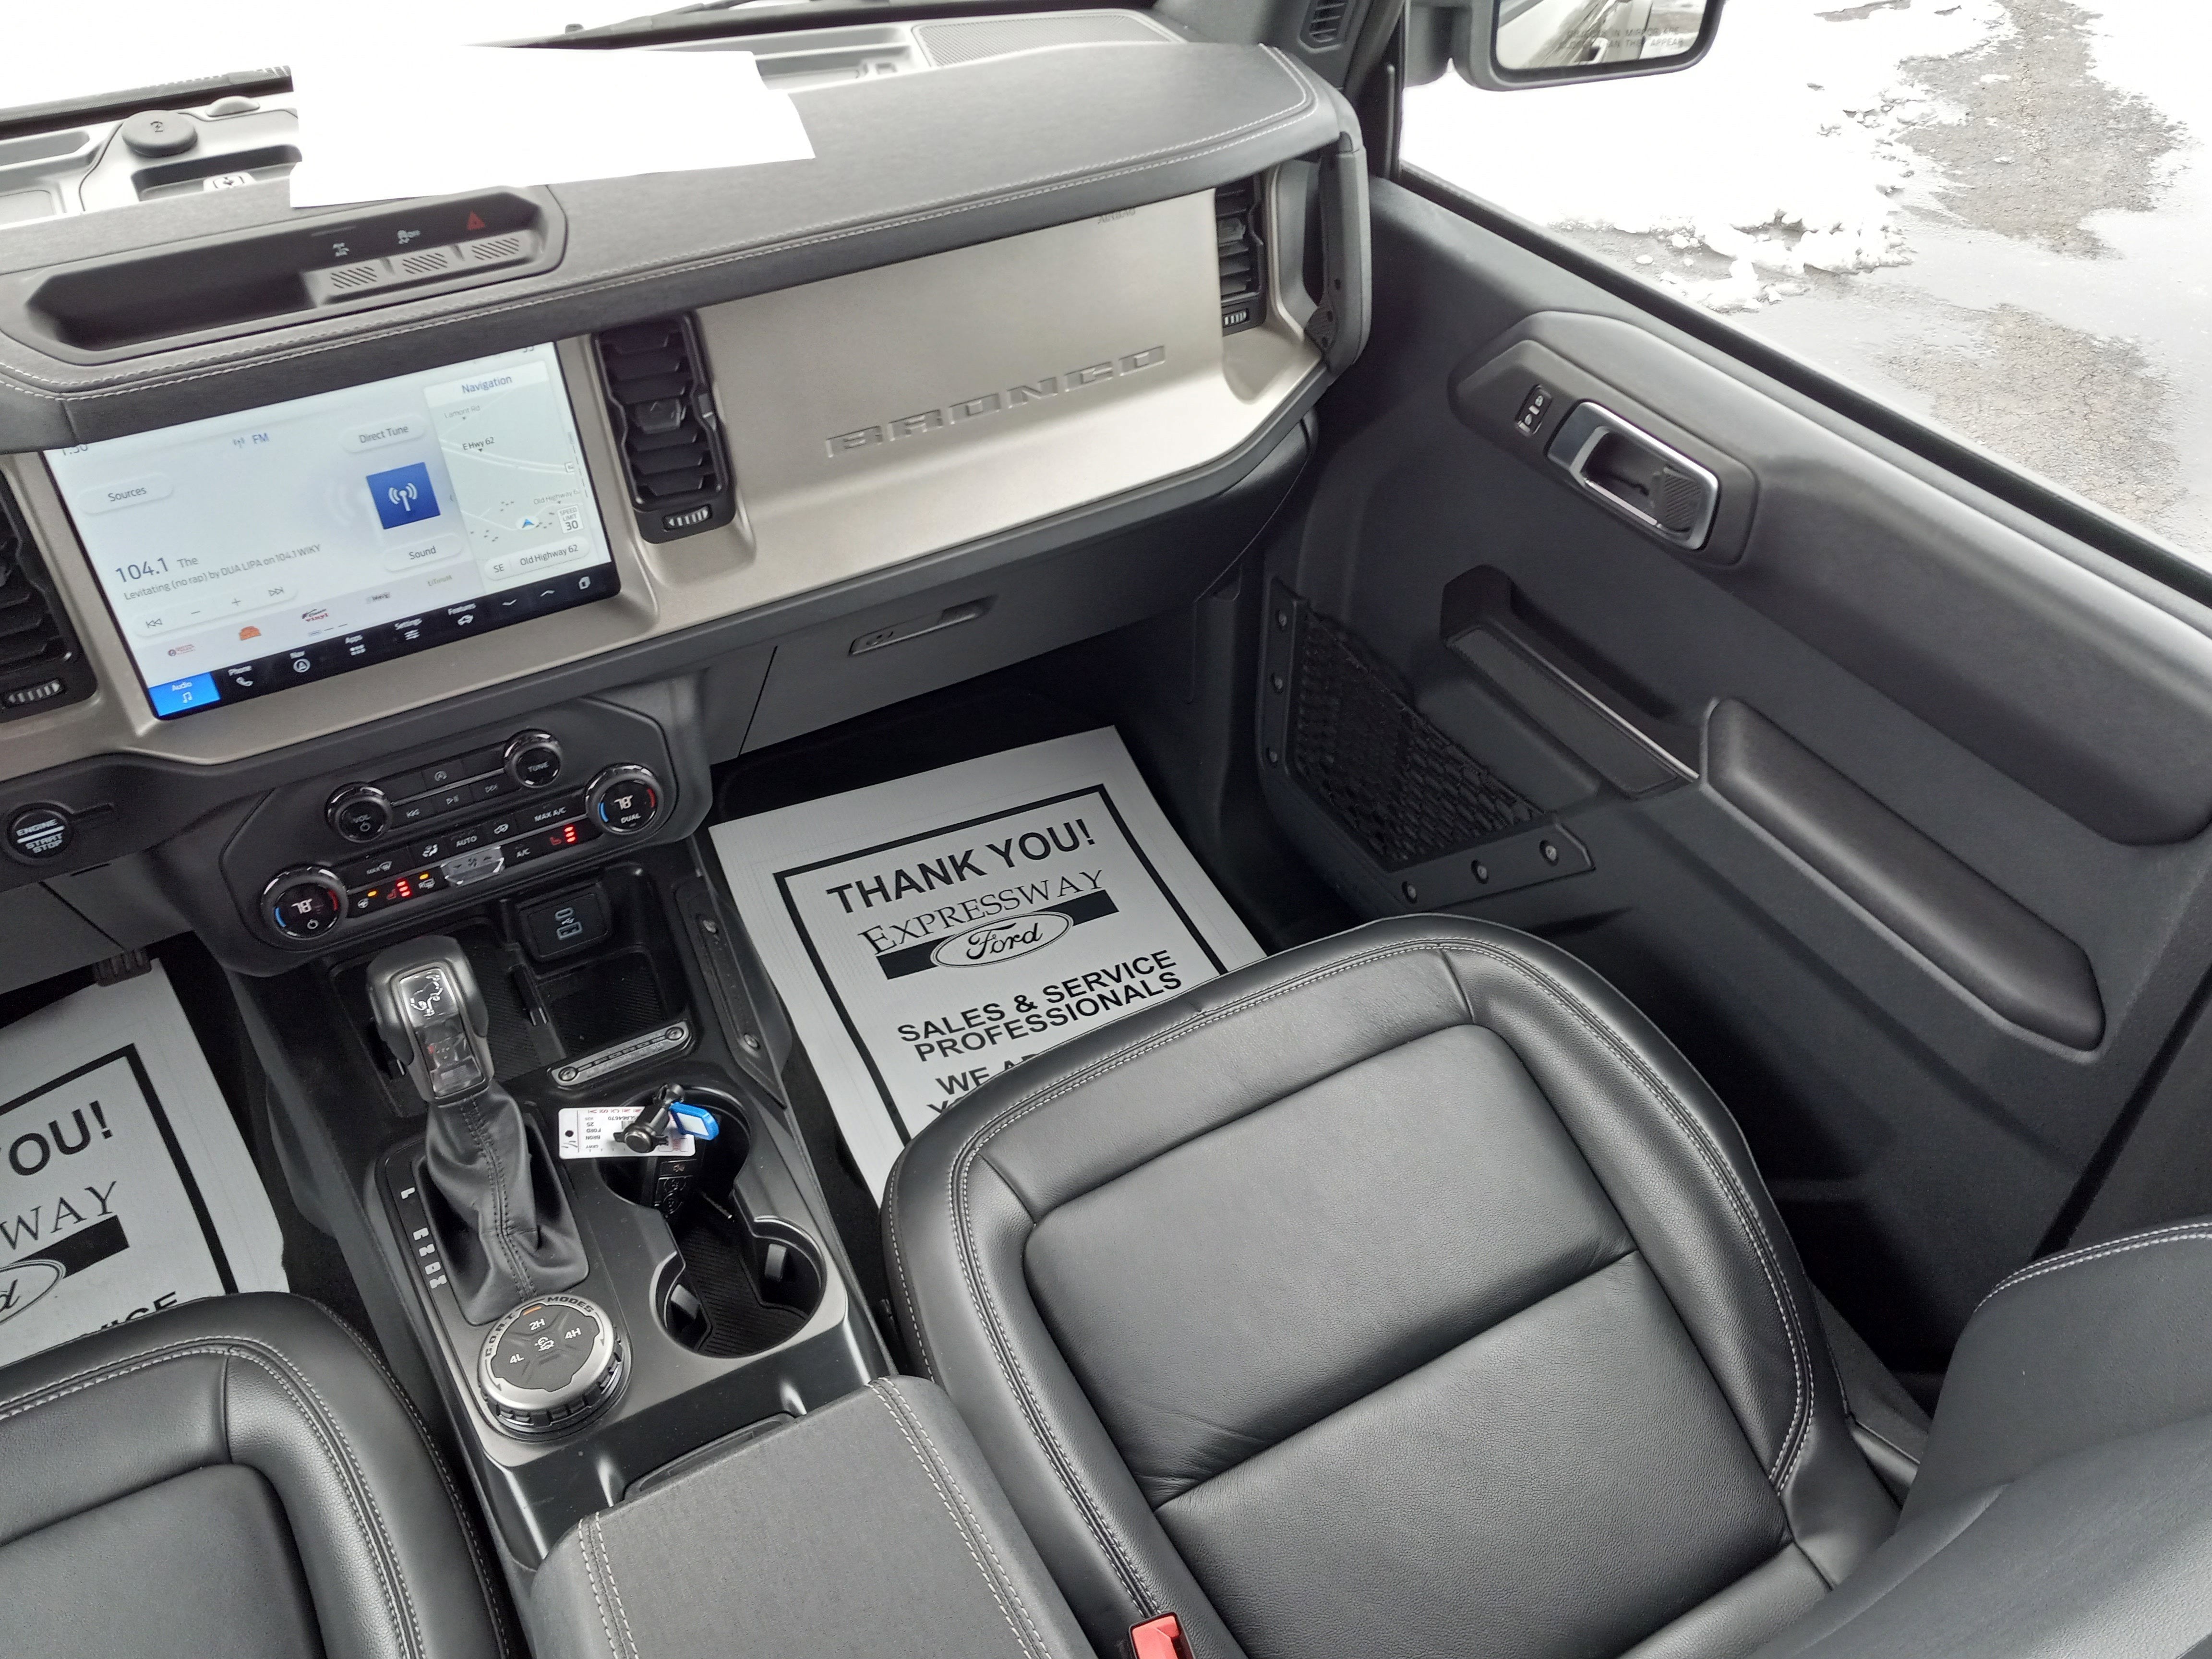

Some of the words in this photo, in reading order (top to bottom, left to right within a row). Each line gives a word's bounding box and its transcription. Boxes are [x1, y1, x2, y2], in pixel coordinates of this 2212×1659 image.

[461, 375, 513, 394] Navigation
[825, 345, 1166, 459] BRONCO
[252, 433, 270, 445] FM
[359, 429, 385, 444] Direct
[385, 424, 409, 438] Tune
[468, 439, 484, 450] Hwy
[485, 436, 495, 445] 62
[108, 487, 147, 502] Sources
[533, 496, 545, 505] Old
[545, 491, 573, 503] Highway
[560, 506, 577, 516] SPEED
[564, 520, 579, 531] 30
[409, 545, 437, 560] Sound
[493, 564, 505, 573] SE
[520, 557, 534, 566] Old
[535, 547, 567, 562] Highway
[567, 544, 579, 553] 62
[116, 557, 169, 583] 104.1
[176, 556, 199, 568] The
[124, 582, 171, 601] Levitating
[209, 569, 220, 581] by
[220, 564, 241, 577] DUA
[241, 559, 263, 572] LIPA
[263, 557, 276, 566] on
[276, 551, 298, 564] 104.1
[297, 544, 321, 558] WIKY
[171, 680, 193, 691] Audio
[527, 761, 550, 773] TUNE
[534, 811, 553, 822] MAX
[553, 806, 567, 817] A/C
[620, 812, 642, 824] DUAL
[16, 818, 58, 836] ENGINE
[25, 832, 63, 849] START
[33, 840, 62, 853] STOP
[456, 835, 478, 848] AUTO
[516, 848, 531, 858] A/C
[825, 850, 988, 915] THANK
[987, 818, 1095, 868] YOU!
[857, 869, 1104, 955] EXPRESSWAY
[964, 920, 1046, 962] Ford
[897, 1002, 1006, 1043] SALES
[1013, 994, 1039, 1013] &
[1042, 949, 1177, 1004] SERVICE
[914, 971, 1182, 1062] PROFESSIONALS
[1, 1100, 113, 1176] OU!
[400, 1187, 416, 1200] P
[413, 1227, 429, 1241] R
[419, 1243, 435, 1257] N
[424, 1261, 441, 1275] D
[429, 1274, 447, 1289] M
[547, 1296, 595, 1313] MODES
[529, 1318, 545, 1331] 2H
[565, 1327, 582, 1340] 4H
[509, 1353, 525, 1364] 4L
